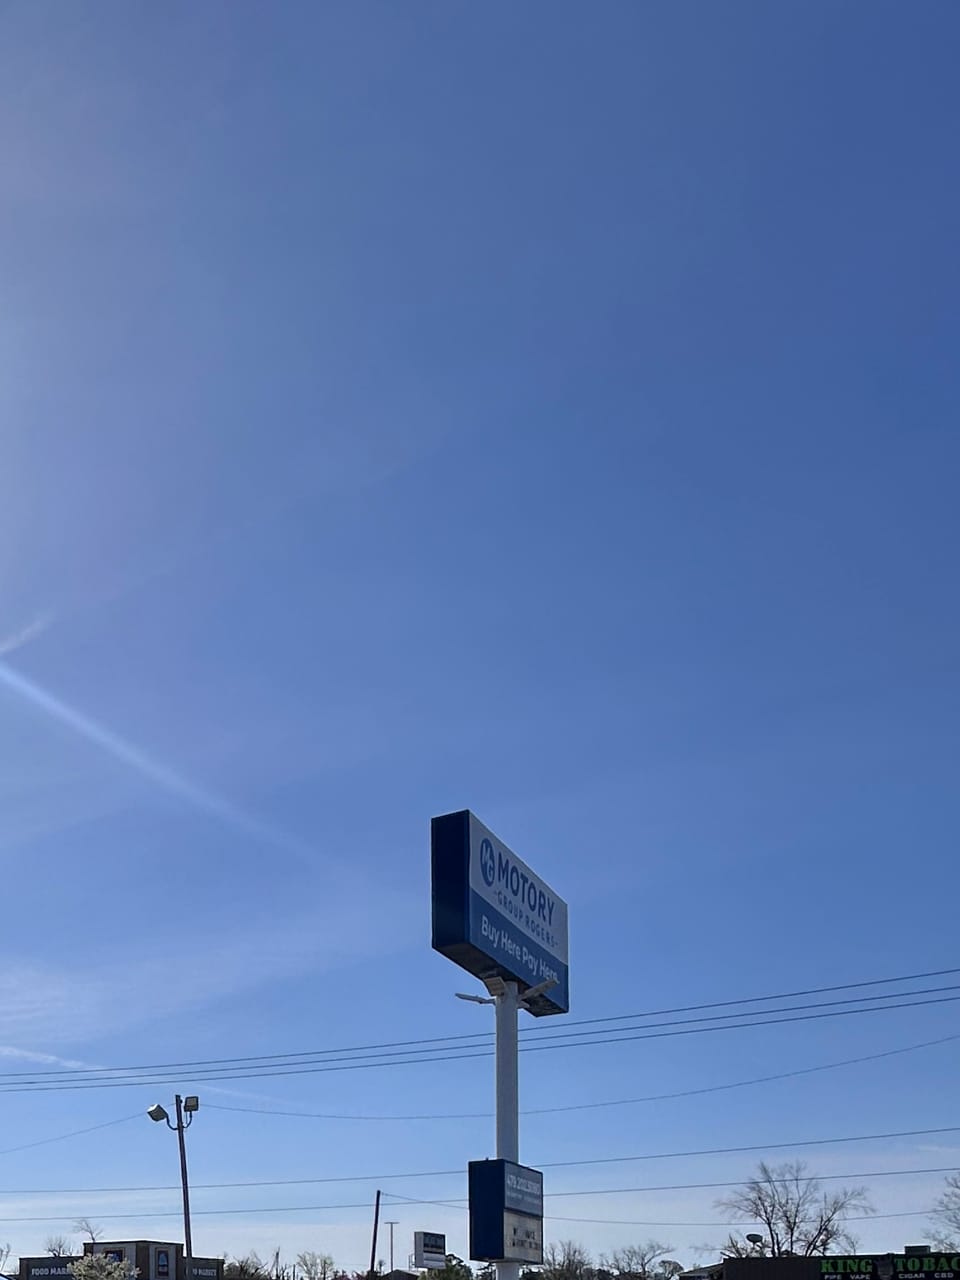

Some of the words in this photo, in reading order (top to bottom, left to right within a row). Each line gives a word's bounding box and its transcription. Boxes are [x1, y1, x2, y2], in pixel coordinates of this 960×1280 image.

[498, 852, 555, 927] MOTORY
[481, 914, 500, 948] Buy
[501, 930, 521, 960] Here
[522, 945, 538, 976] Pay
[31, 1267, 49, 1276] FOOD
[820, 1258, 873, 1273] KING
[850, 1273, 871, 1280] VAPE
[898, 1272, 925, 1280] CIGAR
[934, 1271, 954, 1279] CBD
